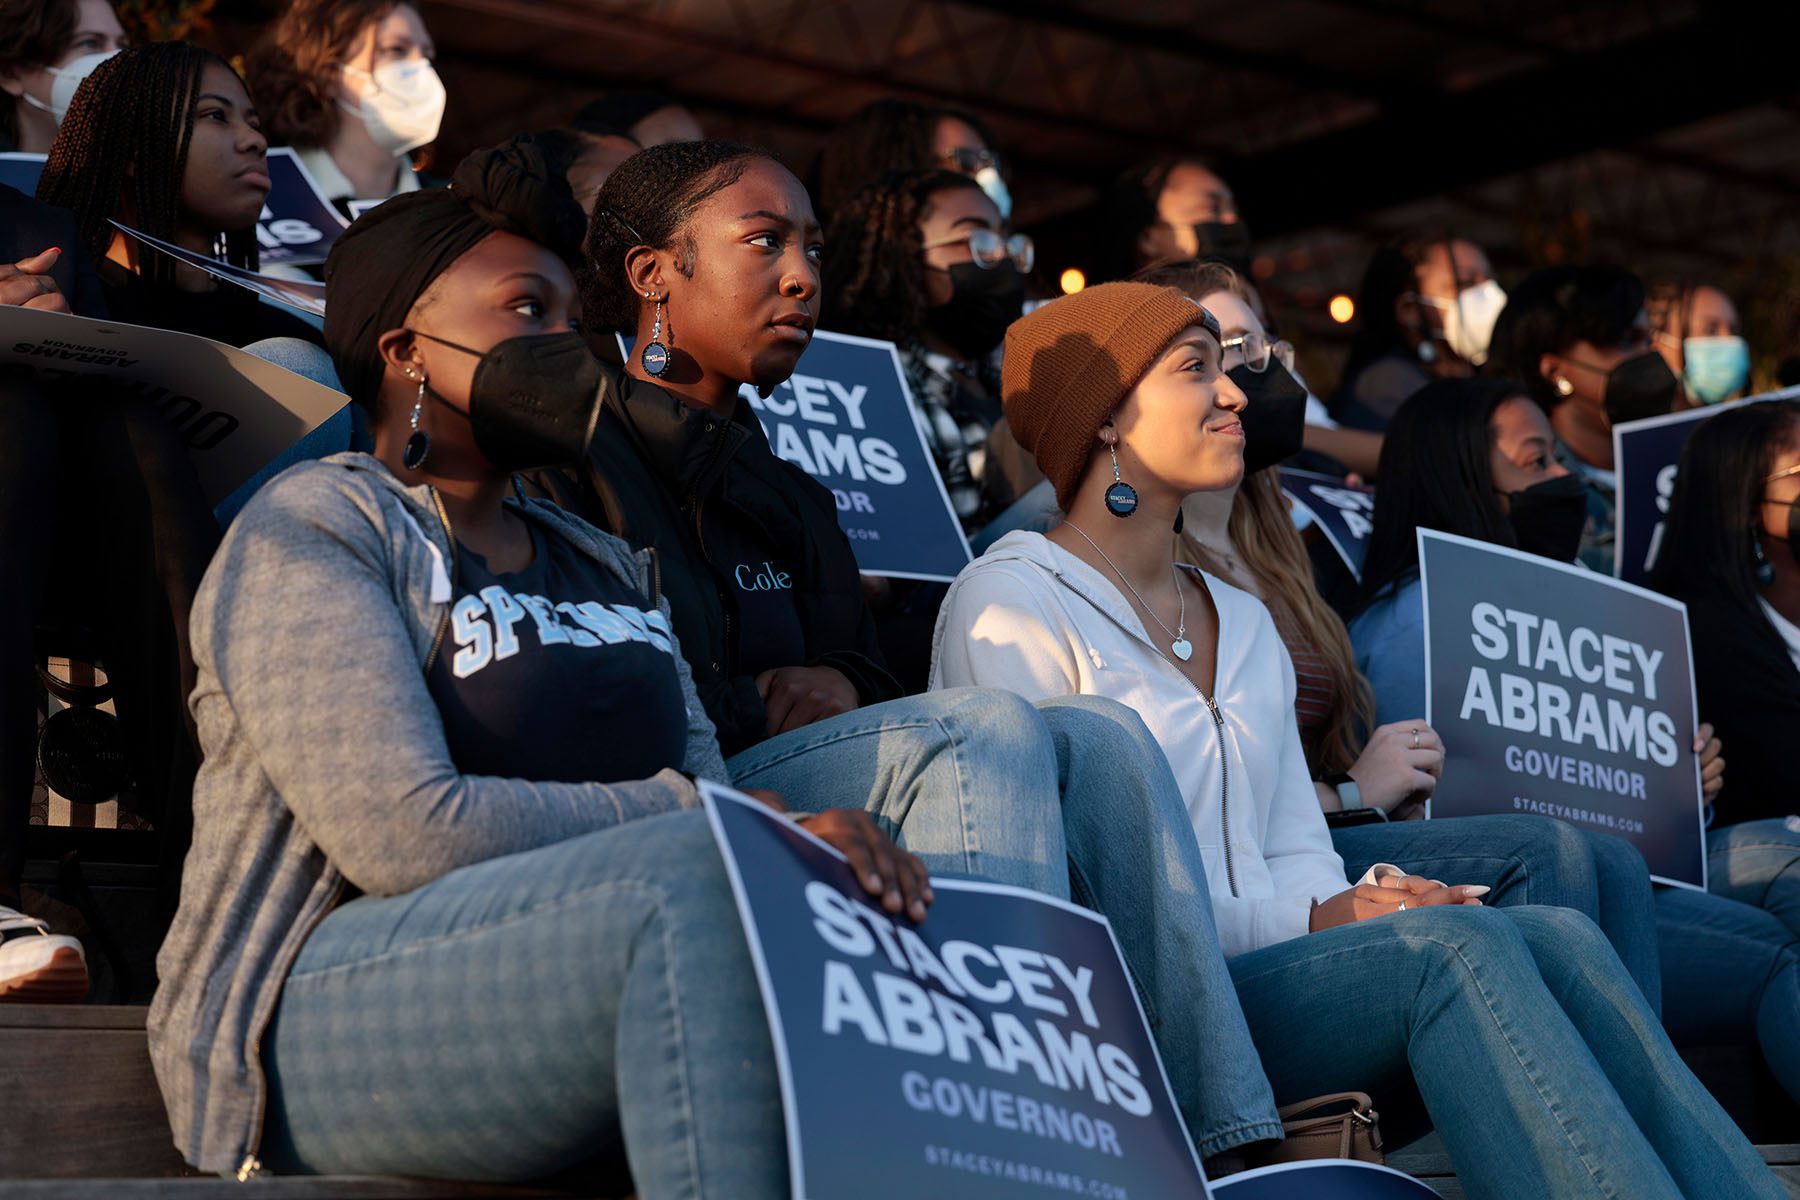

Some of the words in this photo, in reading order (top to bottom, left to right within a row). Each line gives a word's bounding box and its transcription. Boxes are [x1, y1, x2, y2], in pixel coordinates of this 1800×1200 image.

[12, 343, 139, 367] ABRAMS
[776, 422, 907, 485] AMS
[735, 562, 793, 591] Cole
[1471, 602, 1664, 700] STACEY
[1460, 666, 1679, 767] ABRAMS
[1505, 745, 1647, 801] GOVERNOR
[1513, 797, 1644, 834] STACEYABRAMS.COM
[805, 880, 1101, 1029] STACEY
[822, 960, 1153, 1117] ABRAMS
[901, 1070, 1123, 1157] GOVERNOR
[924, 1144, 1128, 1200] STACEYABRAMS.COM
